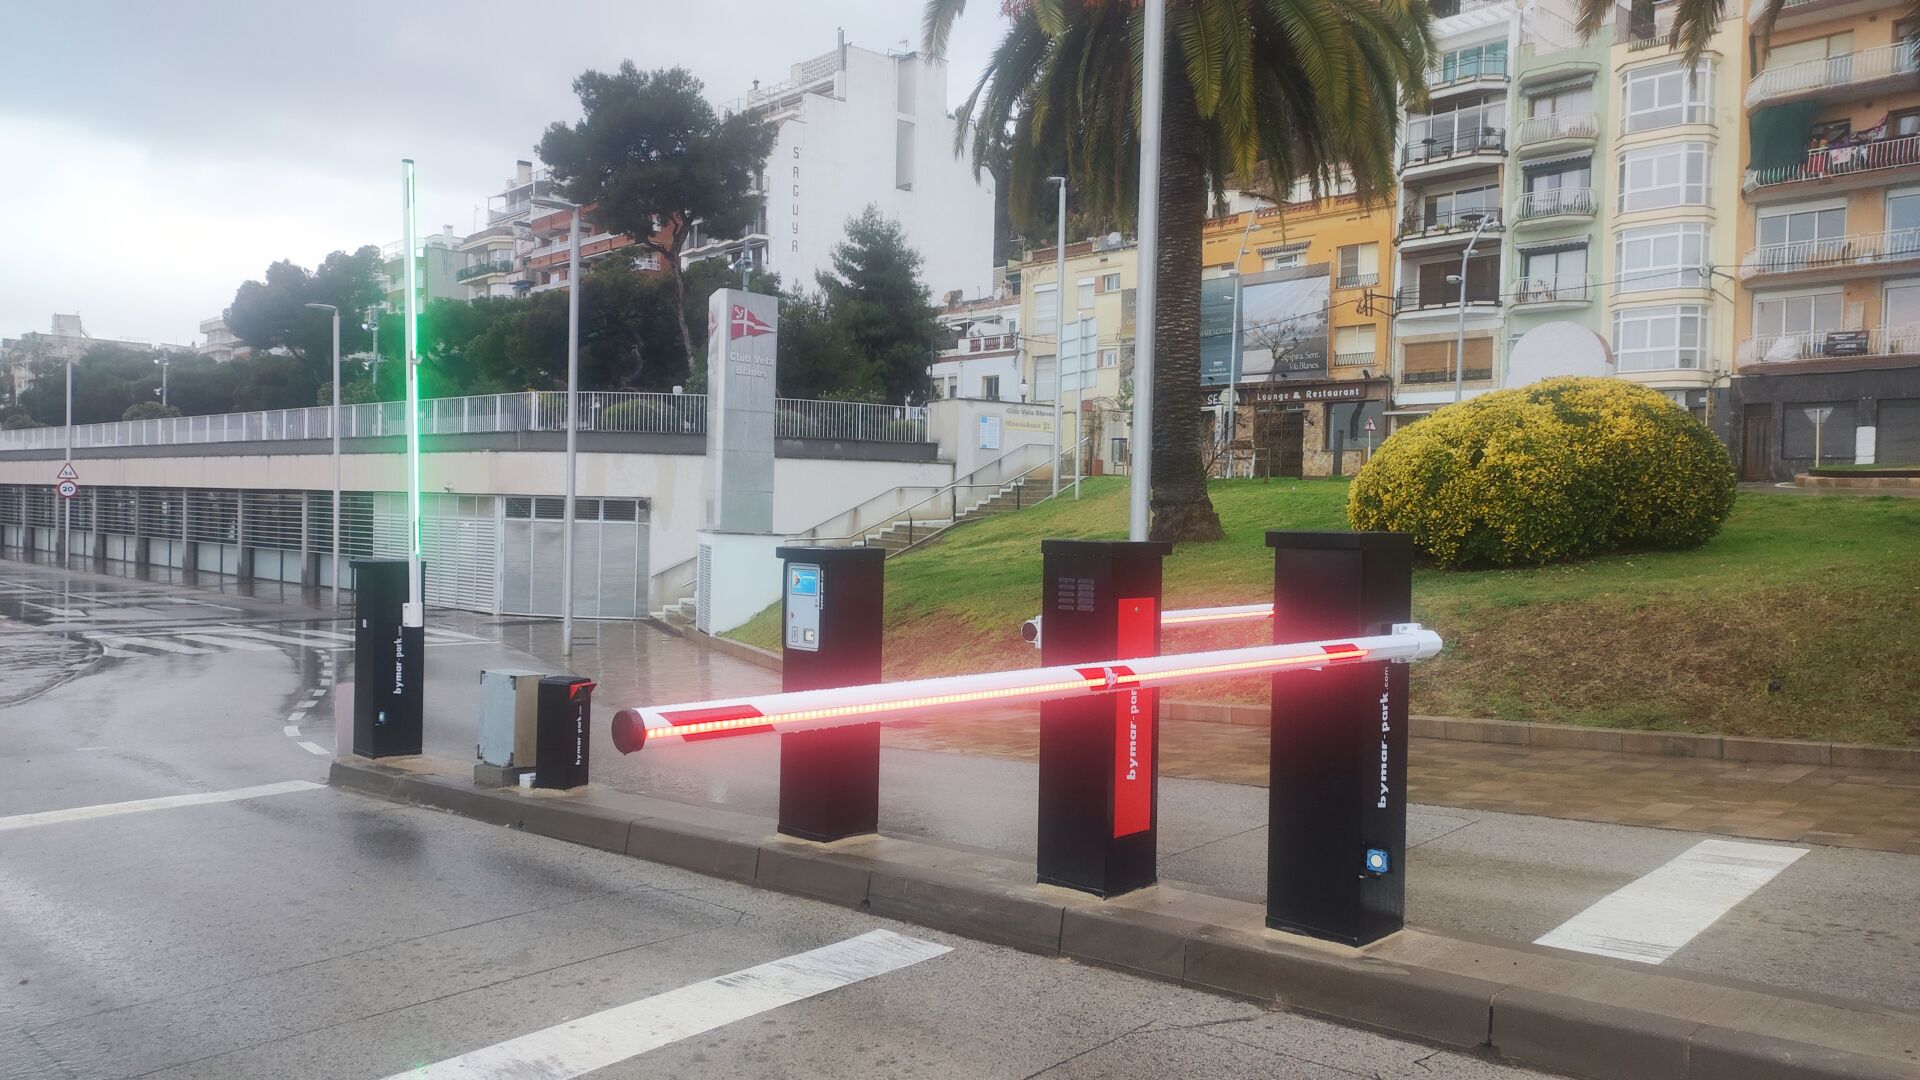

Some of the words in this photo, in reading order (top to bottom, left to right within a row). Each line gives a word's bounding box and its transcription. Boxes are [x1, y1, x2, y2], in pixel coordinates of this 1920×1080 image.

[791, 146, 800, 253] SAGUYA
[729, 351, 751, 363] Club
[753, 354, 775, 367] Vela
[1257, 391, 1289, 402] Lounge
[1306, 387, 1359, 399] Restaurant
[1126, 688, 1140, 781] bymar-par
